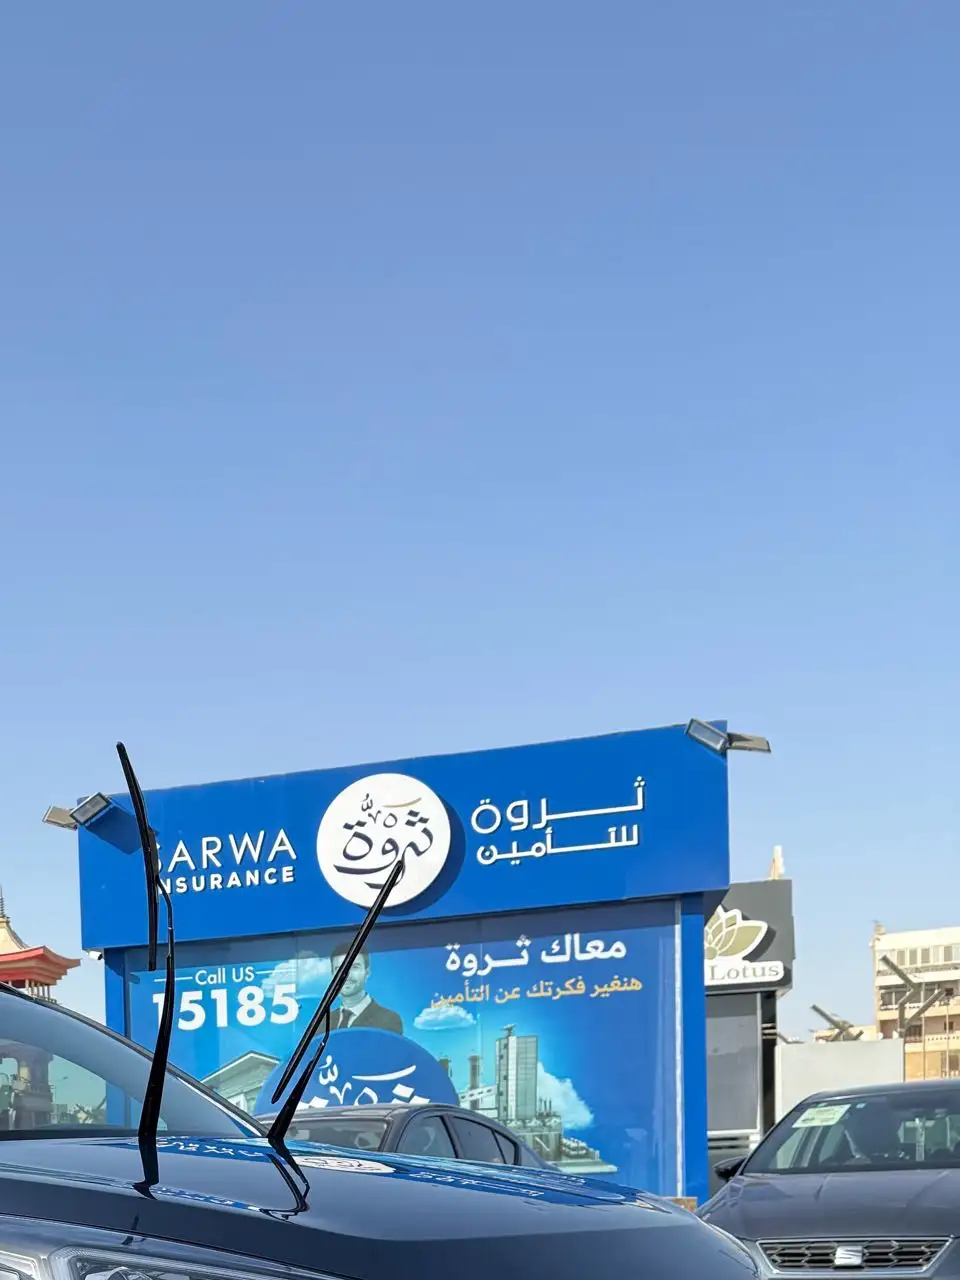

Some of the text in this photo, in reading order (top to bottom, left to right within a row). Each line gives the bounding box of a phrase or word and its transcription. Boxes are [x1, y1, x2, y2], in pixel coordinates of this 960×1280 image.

[471, 776, 645, 834] ثروة
[157, 866, 294, 895] NSURANCE
[445, 932, 627, 977] معاك ثروة
[195, 966, 255, 985] Call US
[709, 965, 780, 980] Lotus
[431, 974, 643, 1009] هنغير فكرتك عن التأمين
